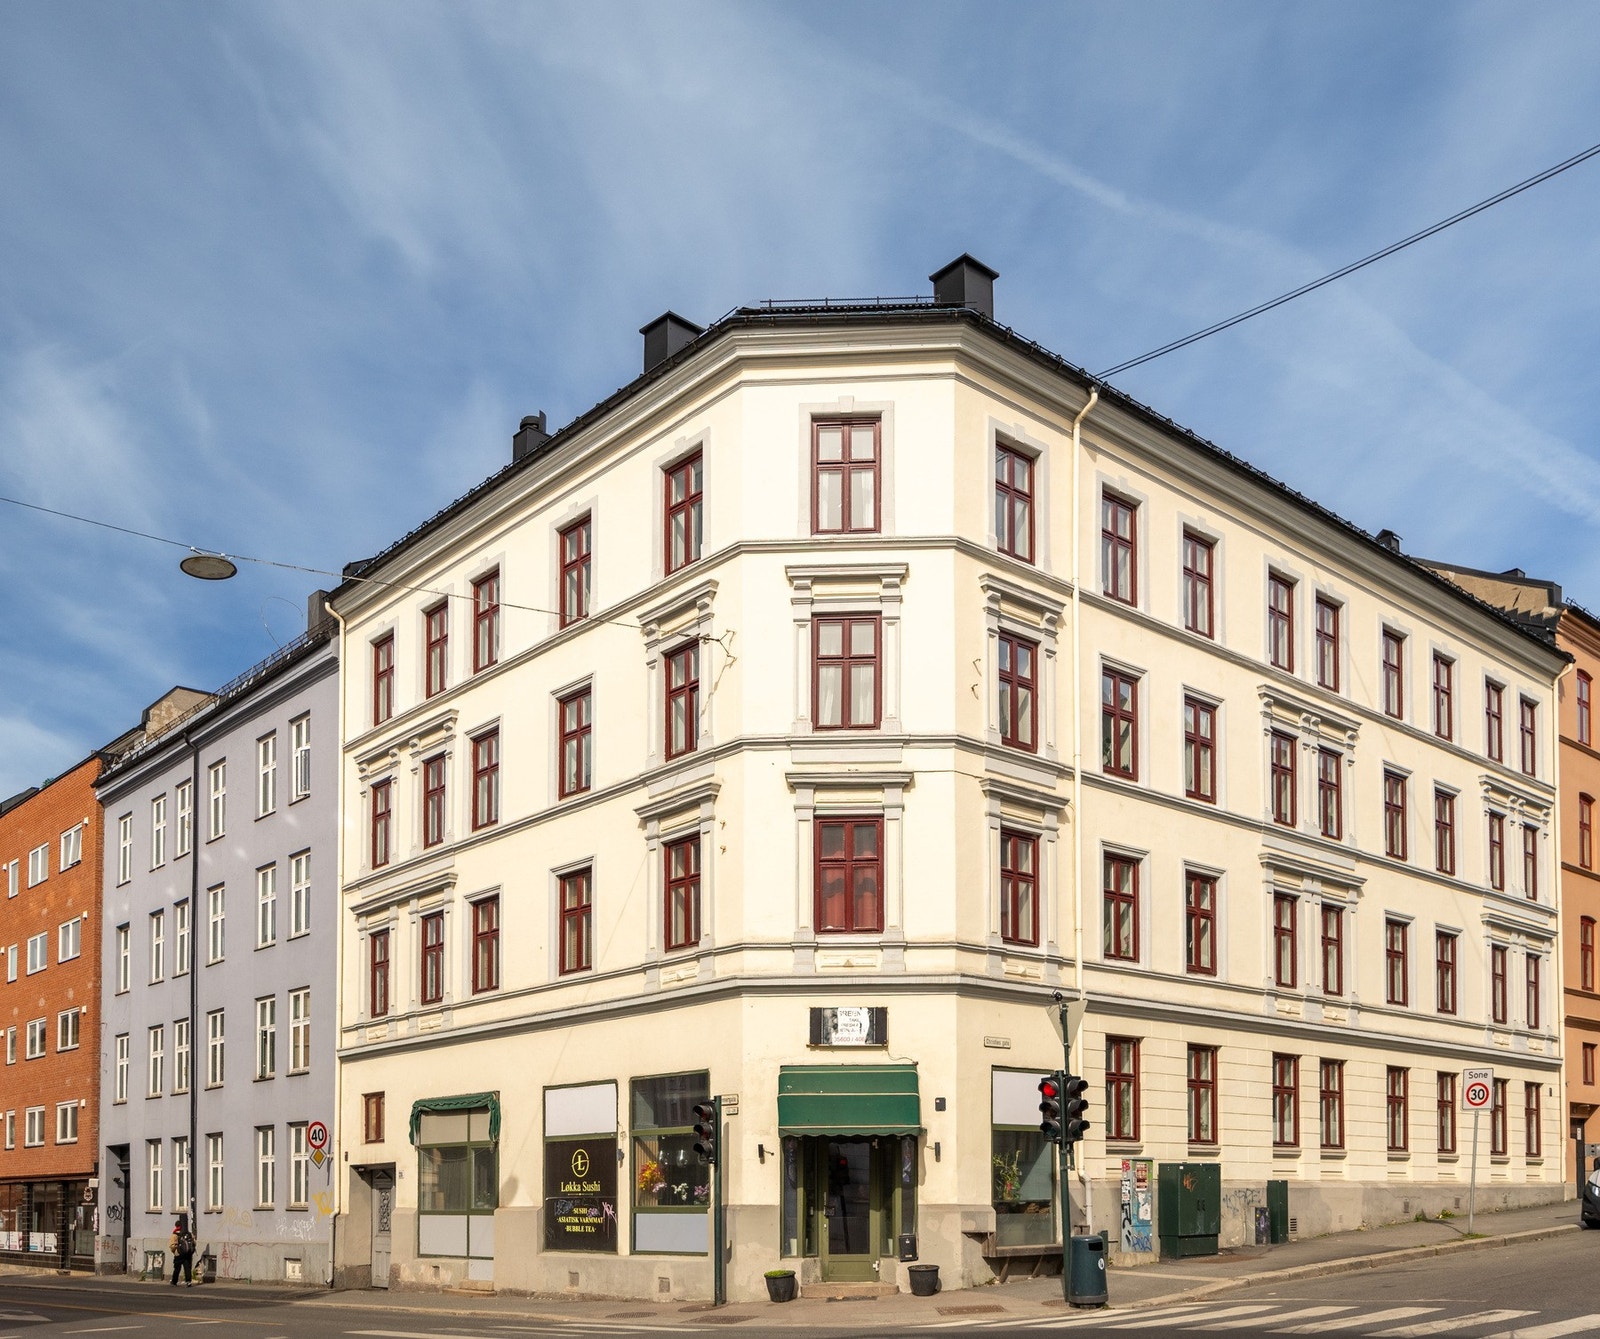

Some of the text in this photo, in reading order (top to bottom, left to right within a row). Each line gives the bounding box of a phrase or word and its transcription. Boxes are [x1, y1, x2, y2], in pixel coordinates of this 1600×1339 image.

[1468, 1071, 1488, 1079] Sone
[1470, 1088, 1485, 1101] 30
[311, 1128, 324, 1142] 40
[561, 1181, 601, 1192] Løkka Sushi
